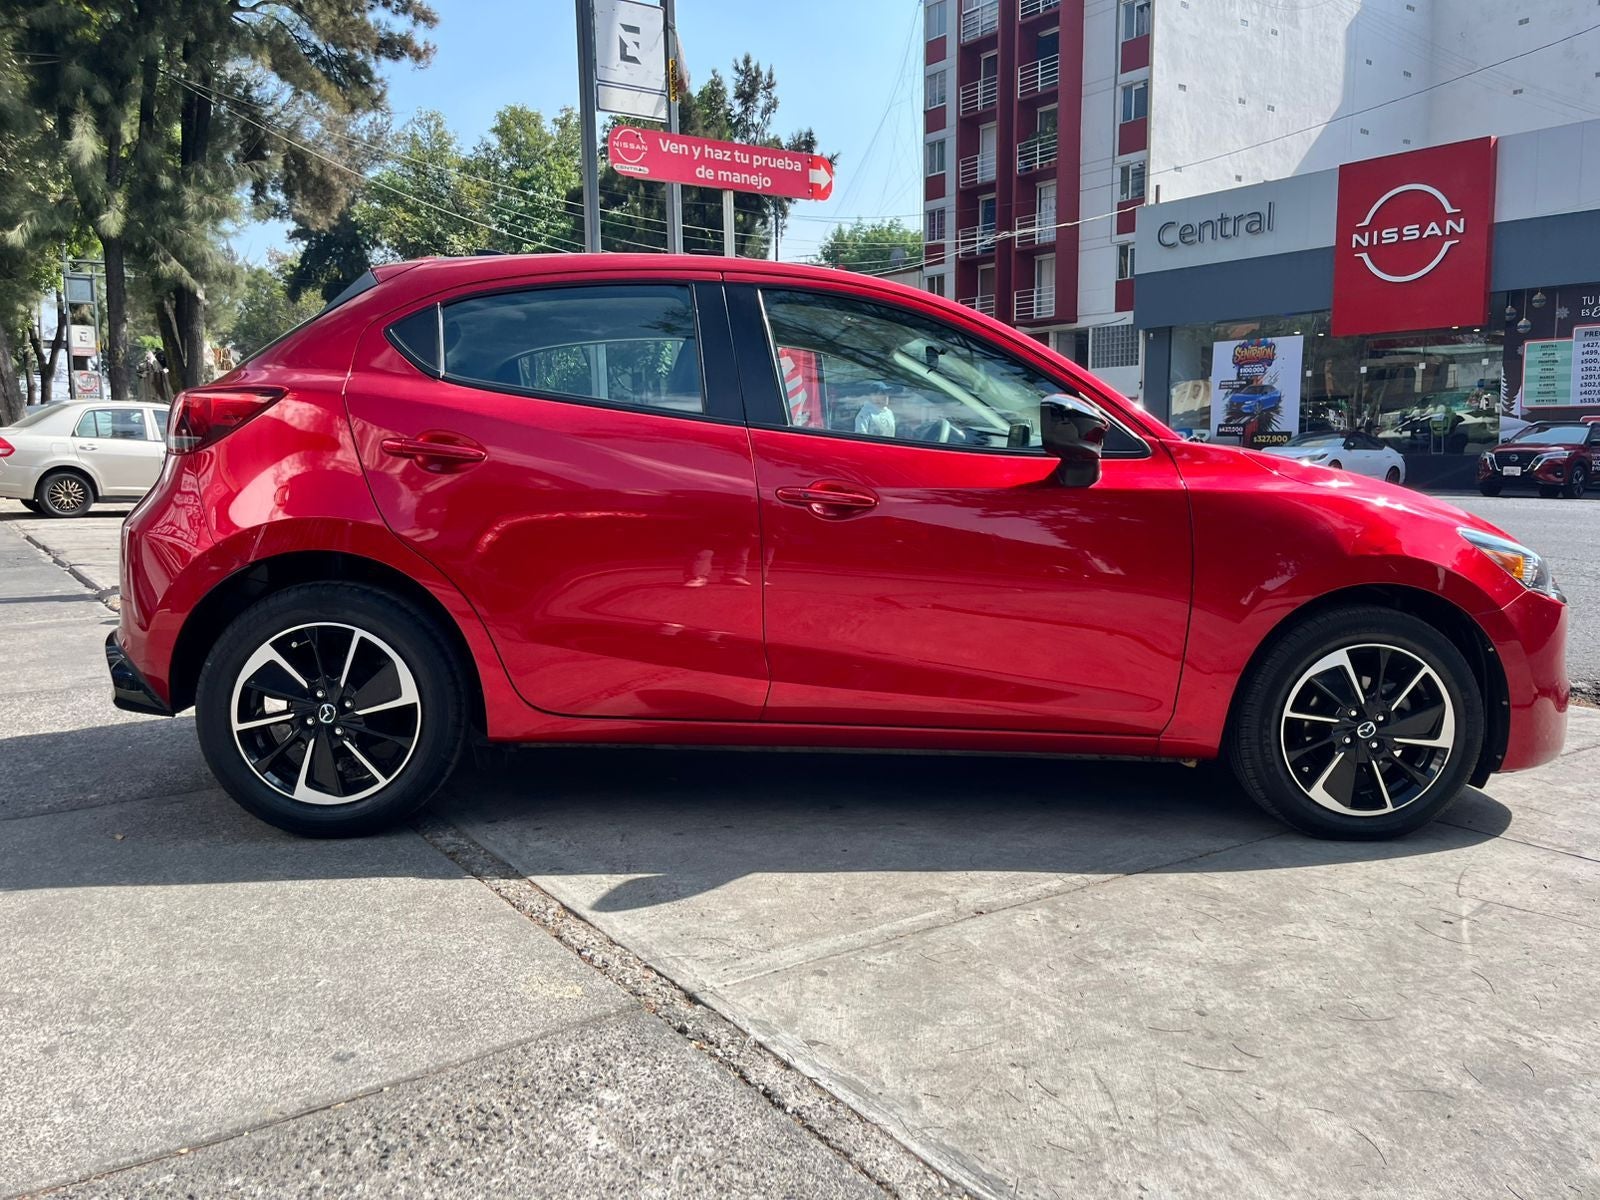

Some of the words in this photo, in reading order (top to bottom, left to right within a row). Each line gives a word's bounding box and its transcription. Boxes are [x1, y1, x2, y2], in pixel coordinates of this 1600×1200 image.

[613, 140, 648, 151] NISSAN
[659, 138, 689, 155] Ven
[691, 145, 702, 160] y
[704, 144, 732, 161] haz
[733, 149, 749, 164] tu
[752, 154, 802, 172] prueba
[695, 165, 715, 180] de
[717, 170, 772, 190] manejo
[1157, 201, 1275, 249] Central
[1351, 217, 1465, 249] NISSAN
[1582, 295, 1595, 306] TU
[1581, 308, 1590, 317] ES
[1584, 330, 1600, 338] PRE
[1254, 435, 1288, 443] $327,900
